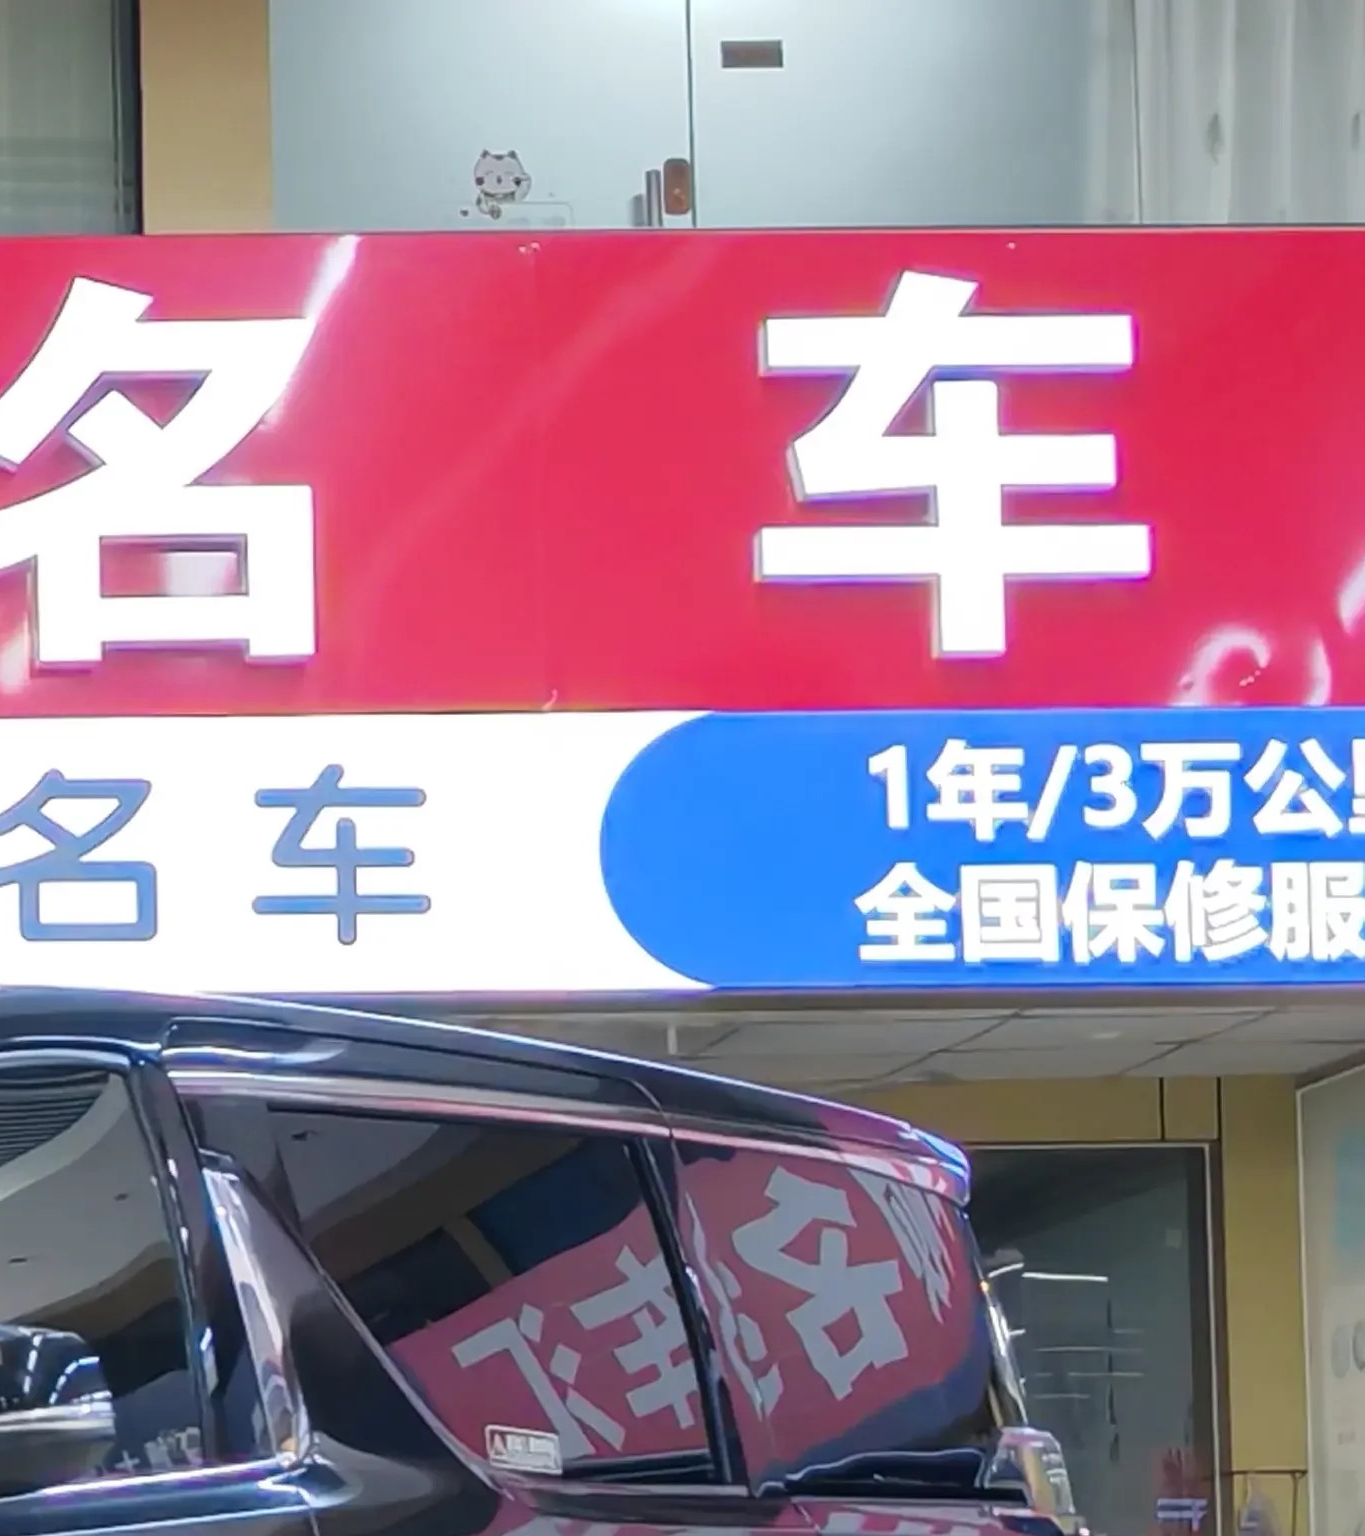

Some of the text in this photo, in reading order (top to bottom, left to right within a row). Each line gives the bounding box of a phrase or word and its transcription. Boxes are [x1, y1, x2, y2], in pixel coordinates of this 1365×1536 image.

[868, 739, 1365, 841] 1年/3万公
[854, 860, 1365, 964] 全国保修服
